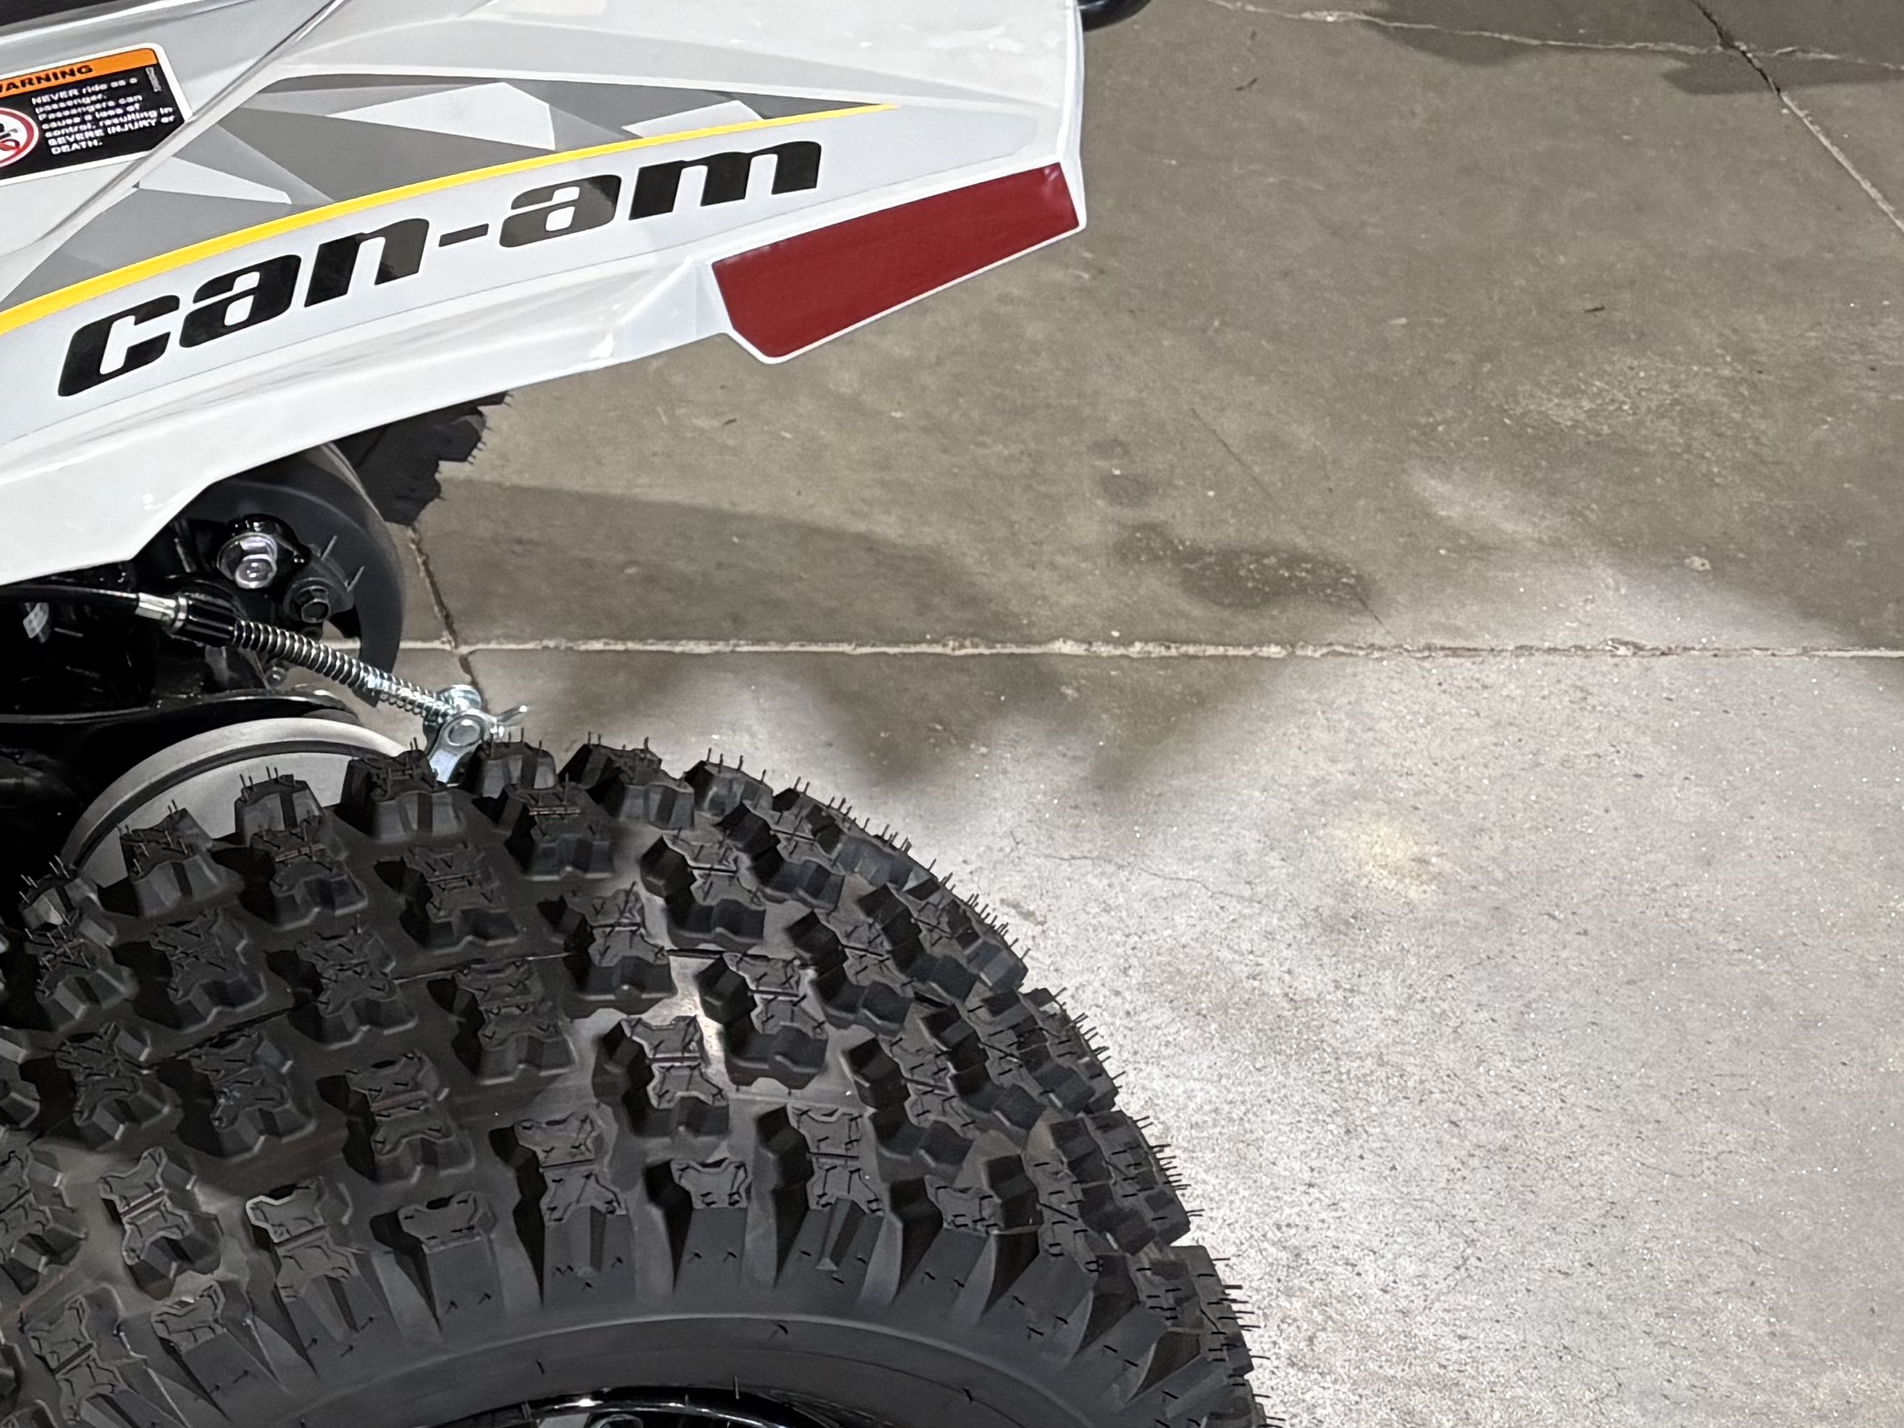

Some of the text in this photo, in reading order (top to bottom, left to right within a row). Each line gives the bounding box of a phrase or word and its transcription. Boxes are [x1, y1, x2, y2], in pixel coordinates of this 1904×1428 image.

[32, 89, 79, 105] NEVER
[82, 84, 108, 94] ride
[110, 79, 126, 88] as
[35, 94, 107, 114] passenger.
[38, 95, 142, 121] Passengers can
[95, 106, 123, 118] loss
[126, 103, 140, 112] of
[99, 110, 158, 127] resulting
[48, 130, 105, 146] SEVERE
[107, 119, 157, 135] INJURY
[51, 139, 103, 155] DEATH.
[56, 138, 823, 399] can-am
